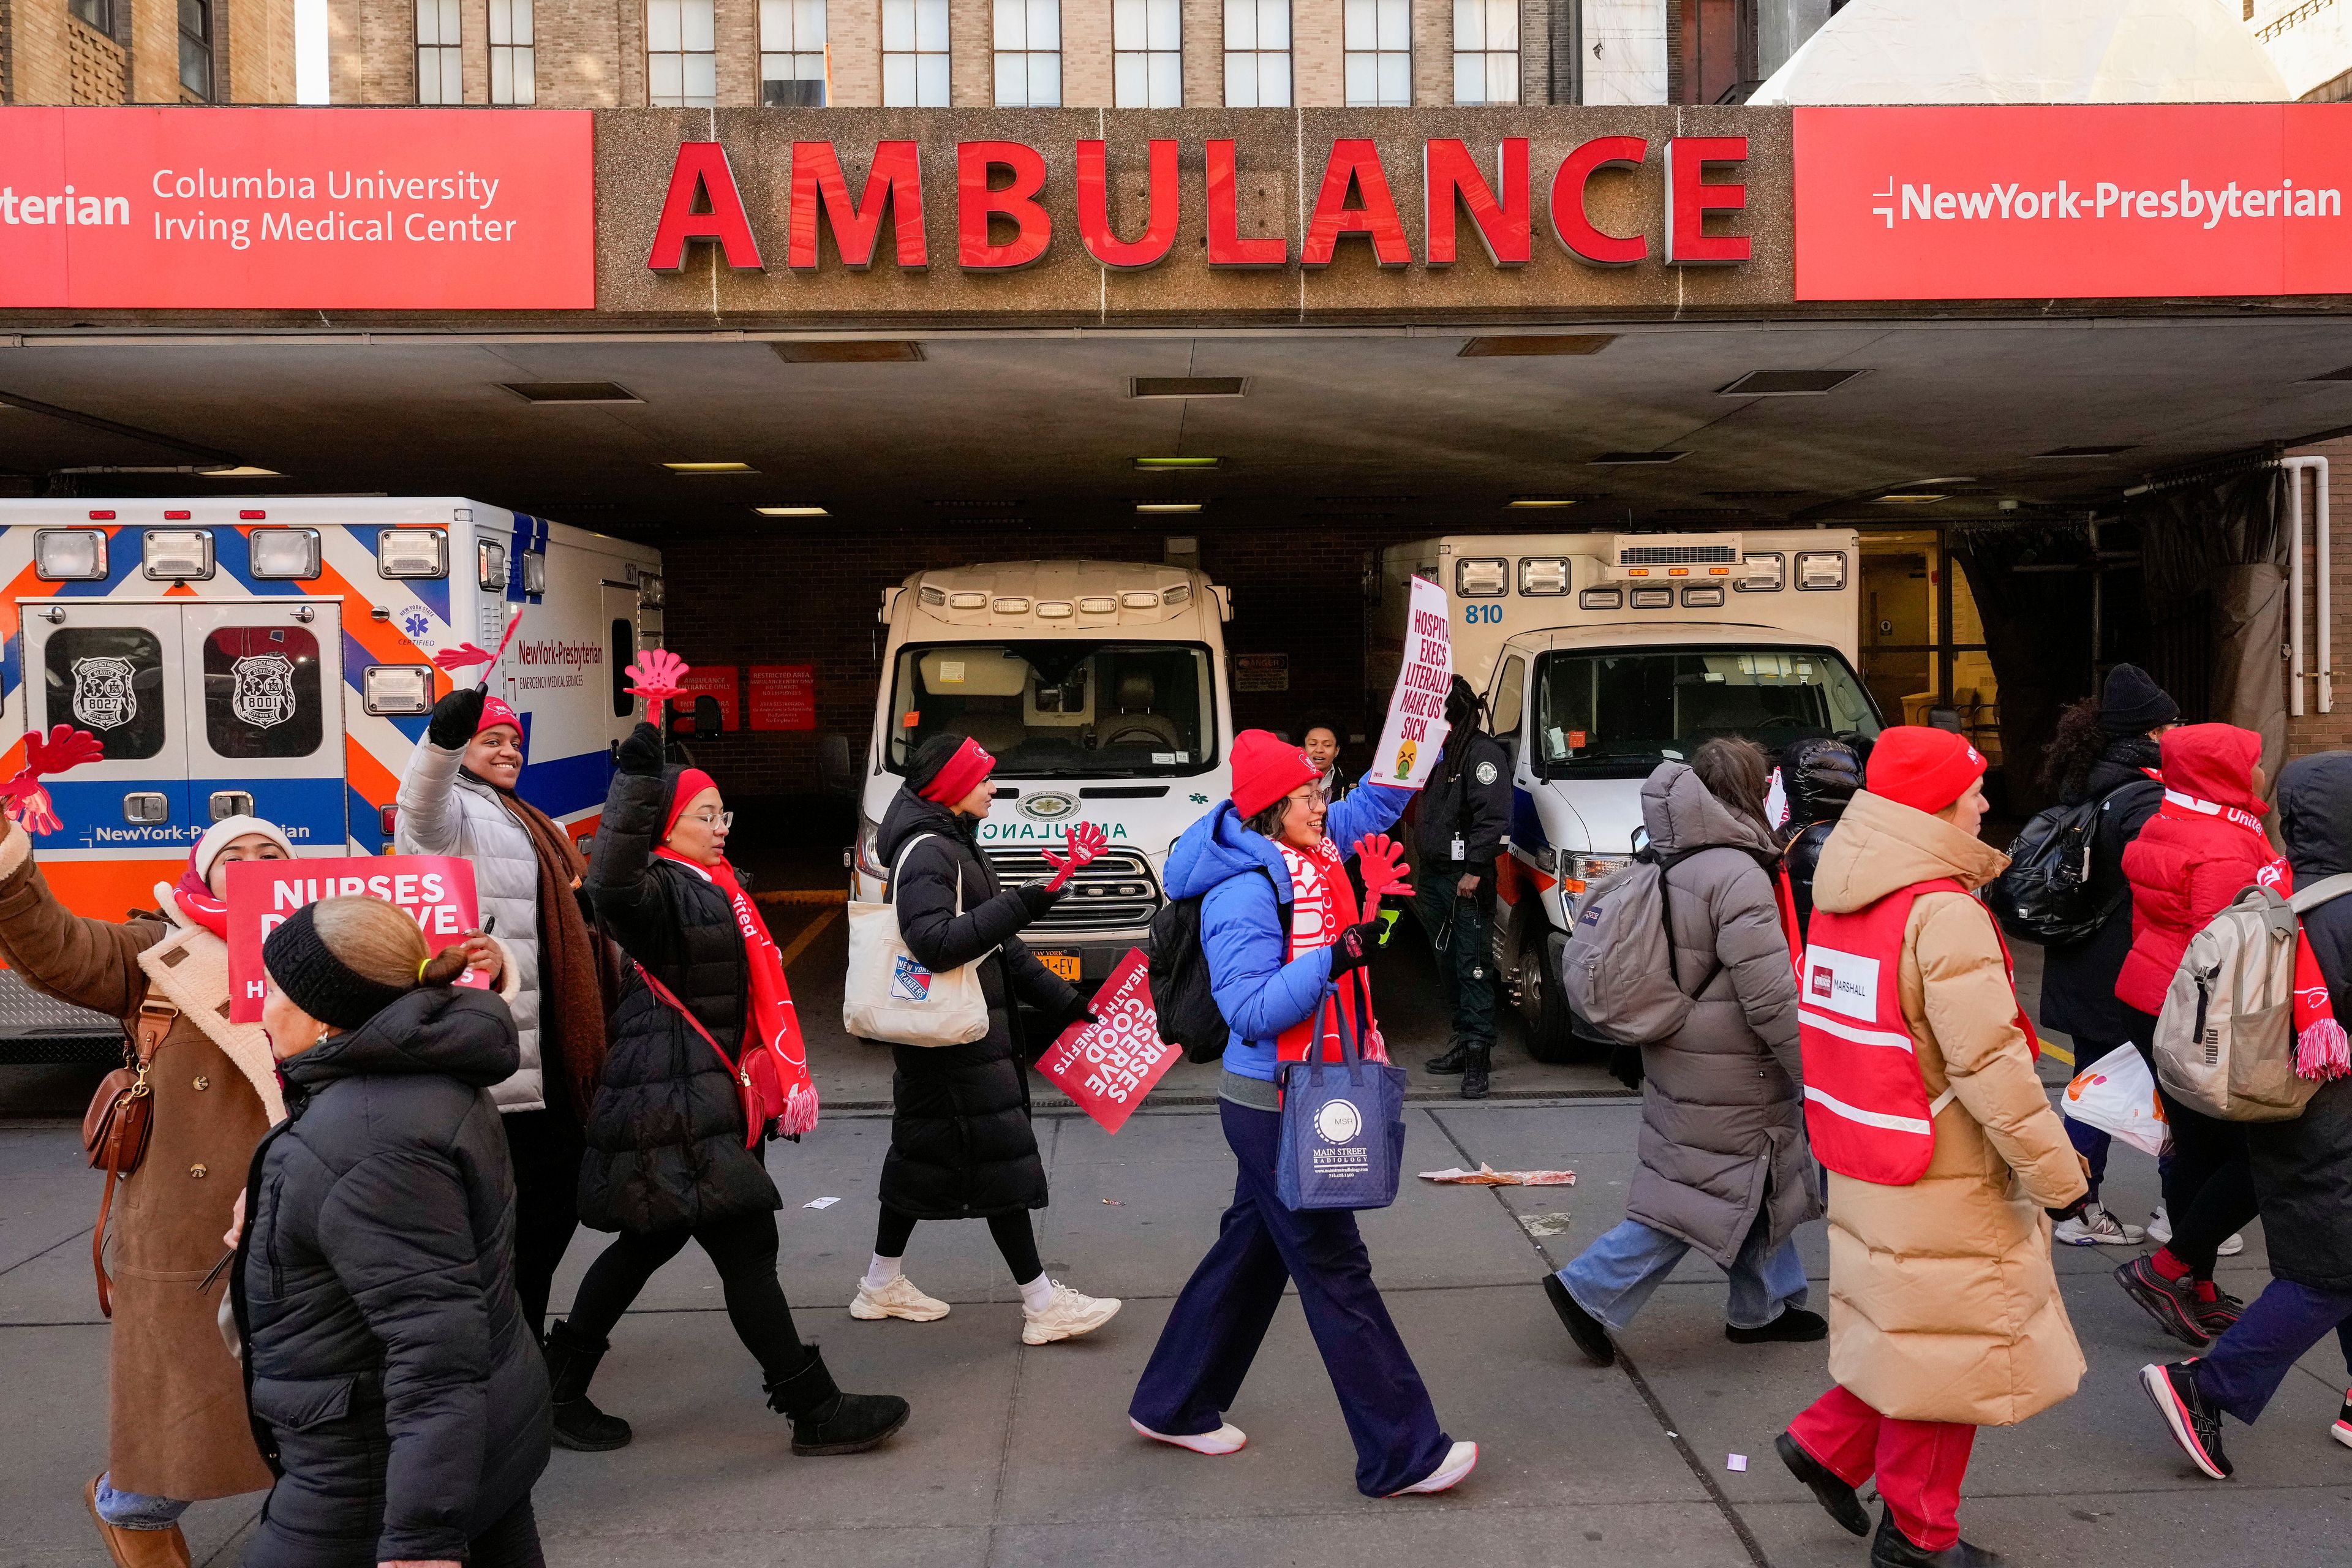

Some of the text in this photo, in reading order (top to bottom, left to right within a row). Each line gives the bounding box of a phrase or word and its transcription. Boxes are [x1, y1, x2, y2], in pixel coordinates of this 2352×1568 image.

[153, 168, 500, 209] Columbia University
[647, 135, 1752, 274] AMBULANCE
[1901, 179, 2342, 230] NewYork-Presbyterian
[154, 211, 517, 250] Irving Medical Center
[625, 563, 637, 581] 1871
[399, 607, 409, 616] NEW
[422, 606, 435, 617] STATE
[1466, 604, 1502, 624] 810
[1414, 609, 1450, 644] HOSPITA
[81, 662, 126, 673] EMERGENCY MEDICAL
[241, 660, 284, 672] EMERGENCY MEDICAL
[519, 639, 602, 671] NewYork-Presbyterian
[1420, 638, 1447, 669] EXEC$
[520, 675, 583, 690] EMERGENCY MEDICAL SERVICES
[1404, 662, 1453, 695] LITERALLY
[89, 699, 118, 709] 8027
[249, 698, 277, 707] 8001
[1400, 689, 1442, 720] MAKE US
[1401, 717, 1428, 743] SICK
[1018, 803, 1037, 820] OUTSTANDING
[1068, 804, 1079, 815] SERVICE
[898, 960, 913, 971] NEW
[1060, 959, 1073, 974] EV
[899, 971, 925, 998] RANGERS
[1834, 979, 1865, 997] MARSHALL
[1054, 963, 1148, 1075] HEALTH BENEFITS
[1085, 998, 1144, 1063] GOOD
[1084, 1008, 1158, 1096] ESERVE
[2205, 1028, 2218, 1064] PUMA
[1107, 1035, 1167, 1103] URSES
